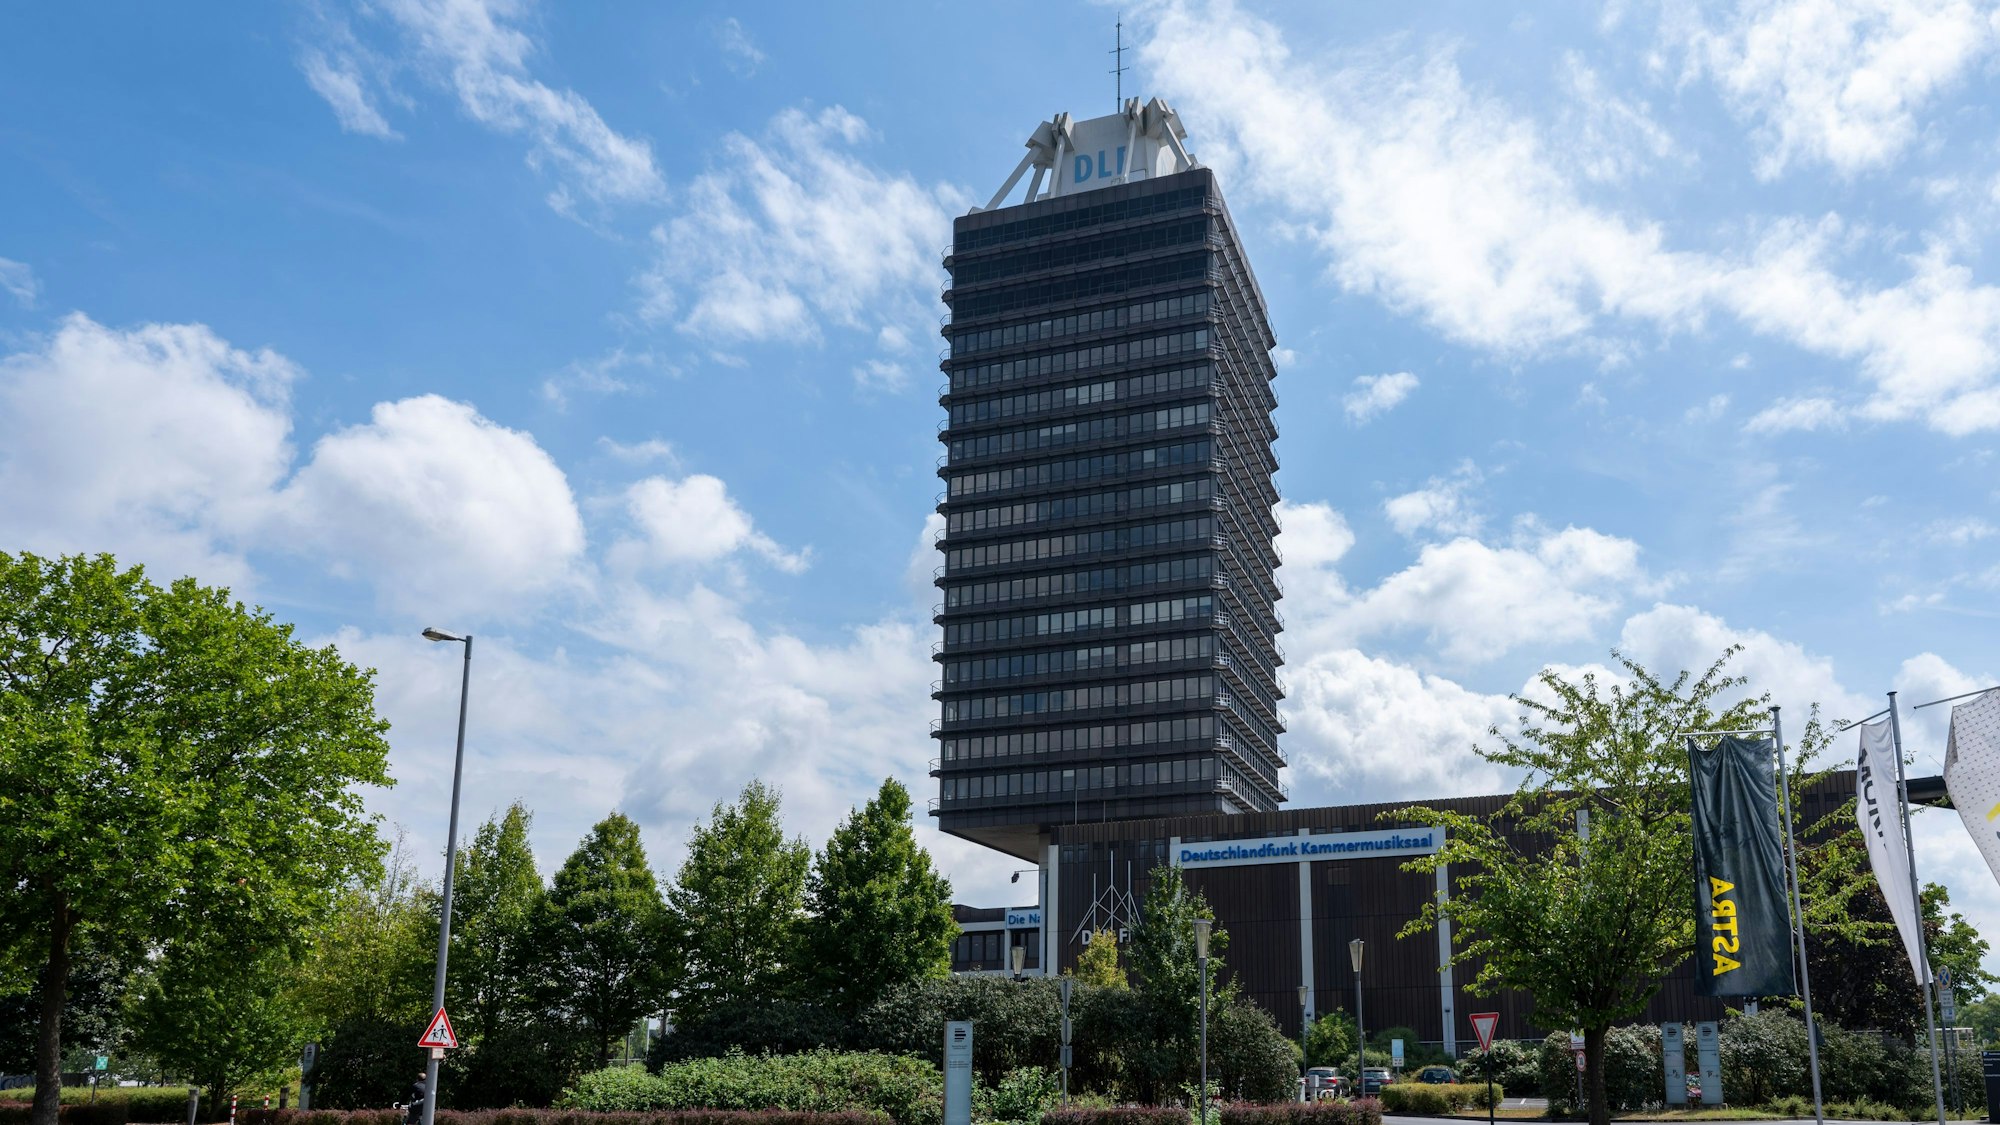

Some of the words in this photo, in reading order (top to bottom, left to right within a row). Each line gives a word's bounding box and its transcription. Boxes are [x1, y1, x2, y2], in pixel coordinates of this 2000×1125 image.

[1181, 842, 1298, 862] Deutschlandfunk
[1301, 833, 1432, 855] Kammermusiksaal
[1008, 914, 1025, 925] Die
[1081, 928, 1128, 945] DF
